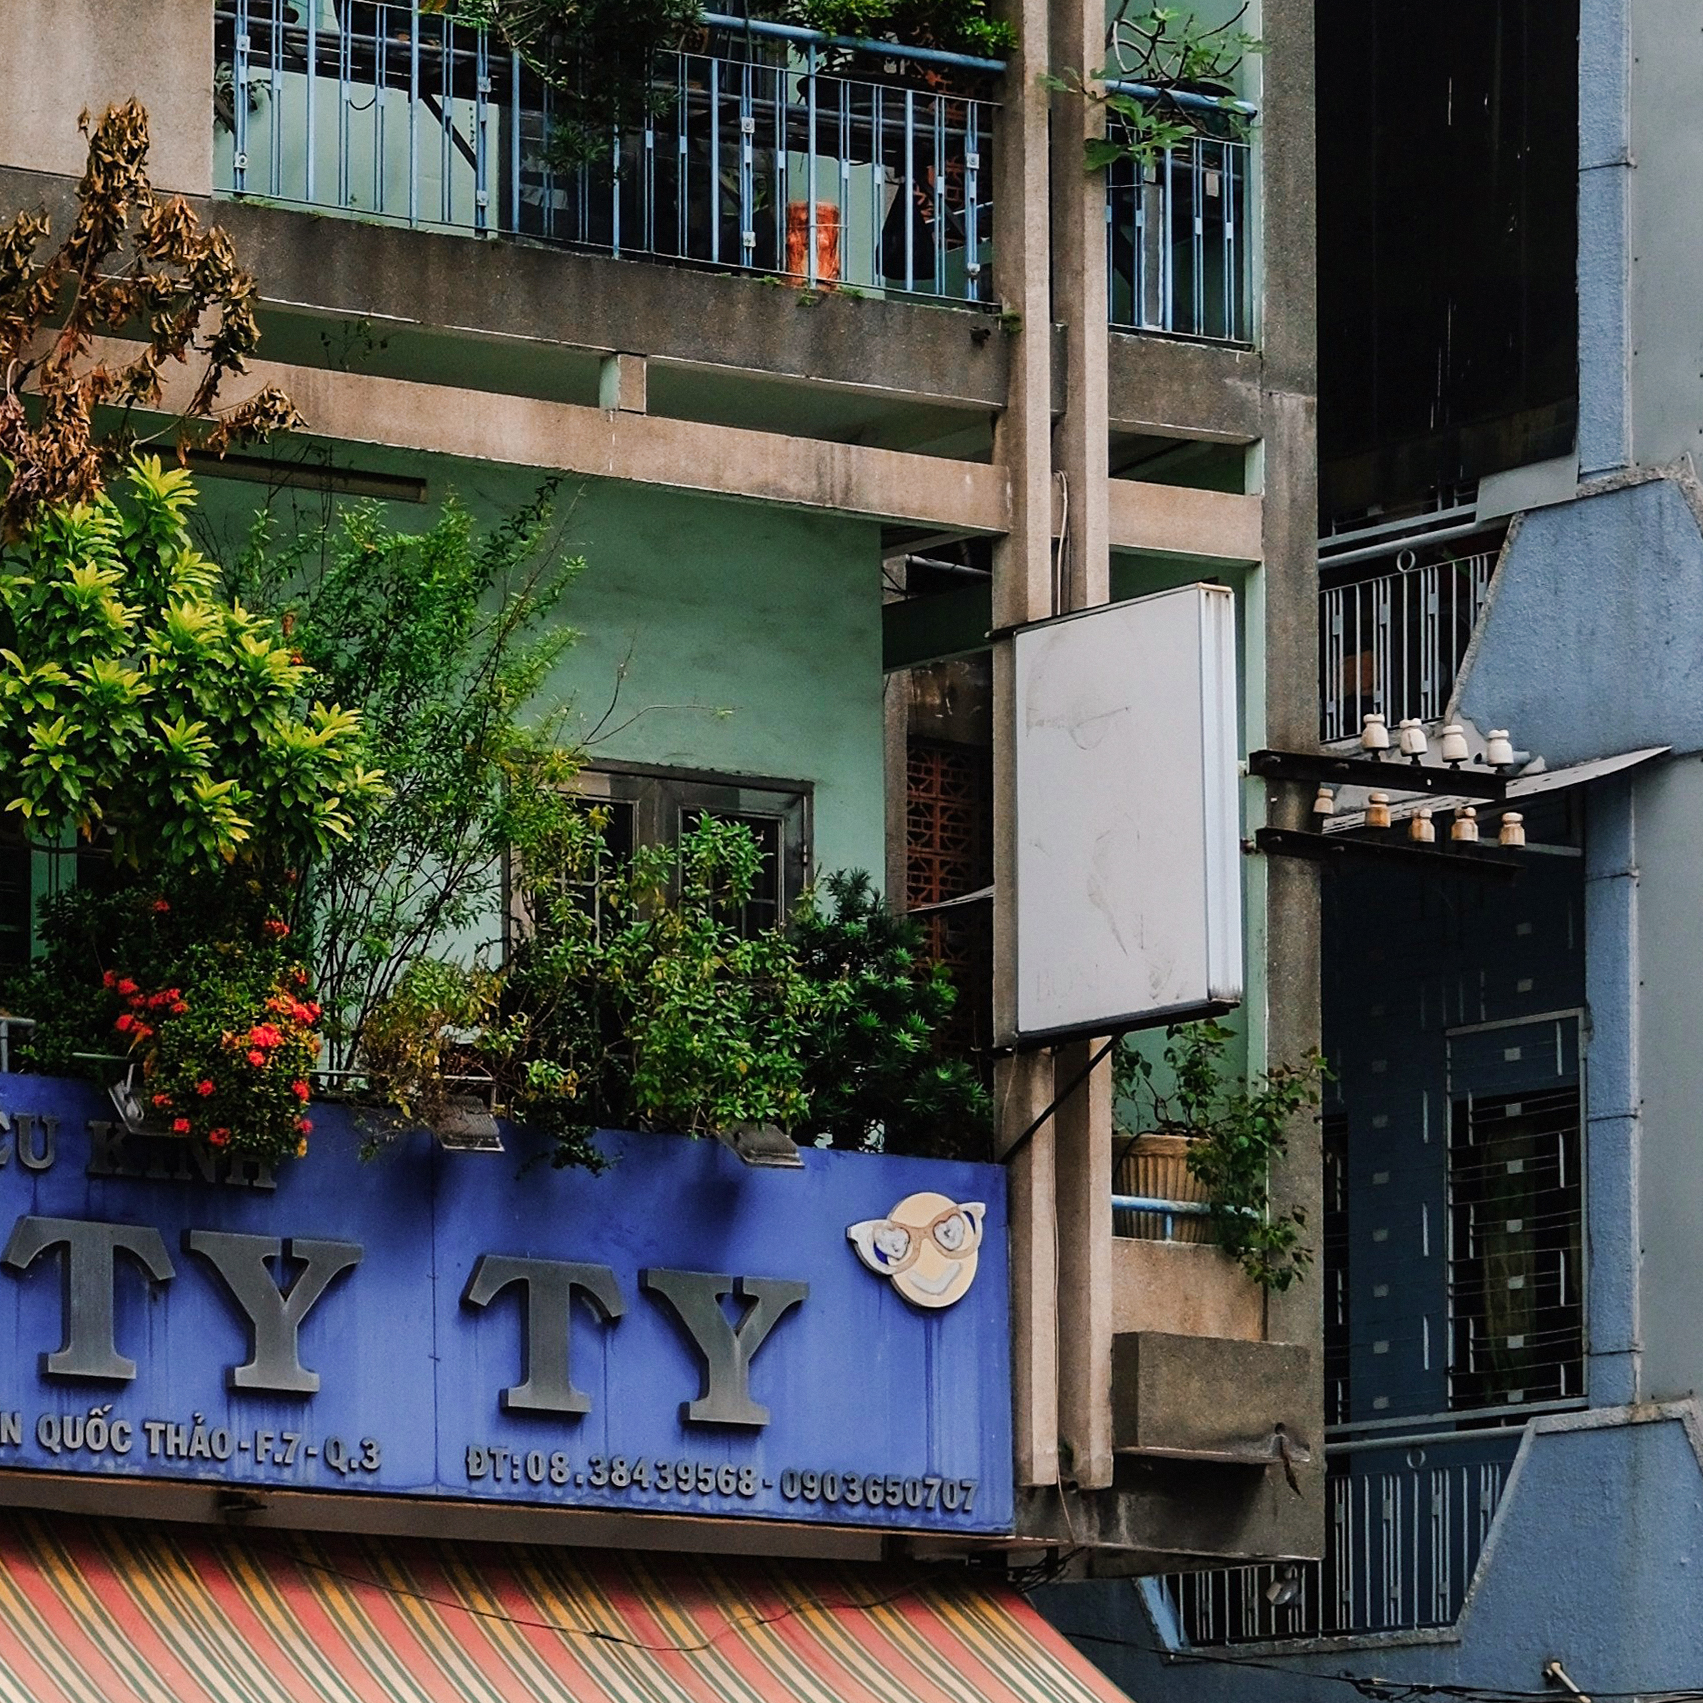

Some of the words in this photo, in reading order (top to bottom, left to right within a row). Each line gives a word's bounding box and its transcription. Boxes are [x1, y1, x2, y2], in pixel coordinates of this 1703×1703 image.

[38, 1404, 133, 1454] QUỐC
[144, 1412, 230, 1461] THẢO
[254, 1429, 301, 1466] F.7
[323, 1436, 383, 1472] Q.3
[780, 1467, 979, 1513] 0903650707
